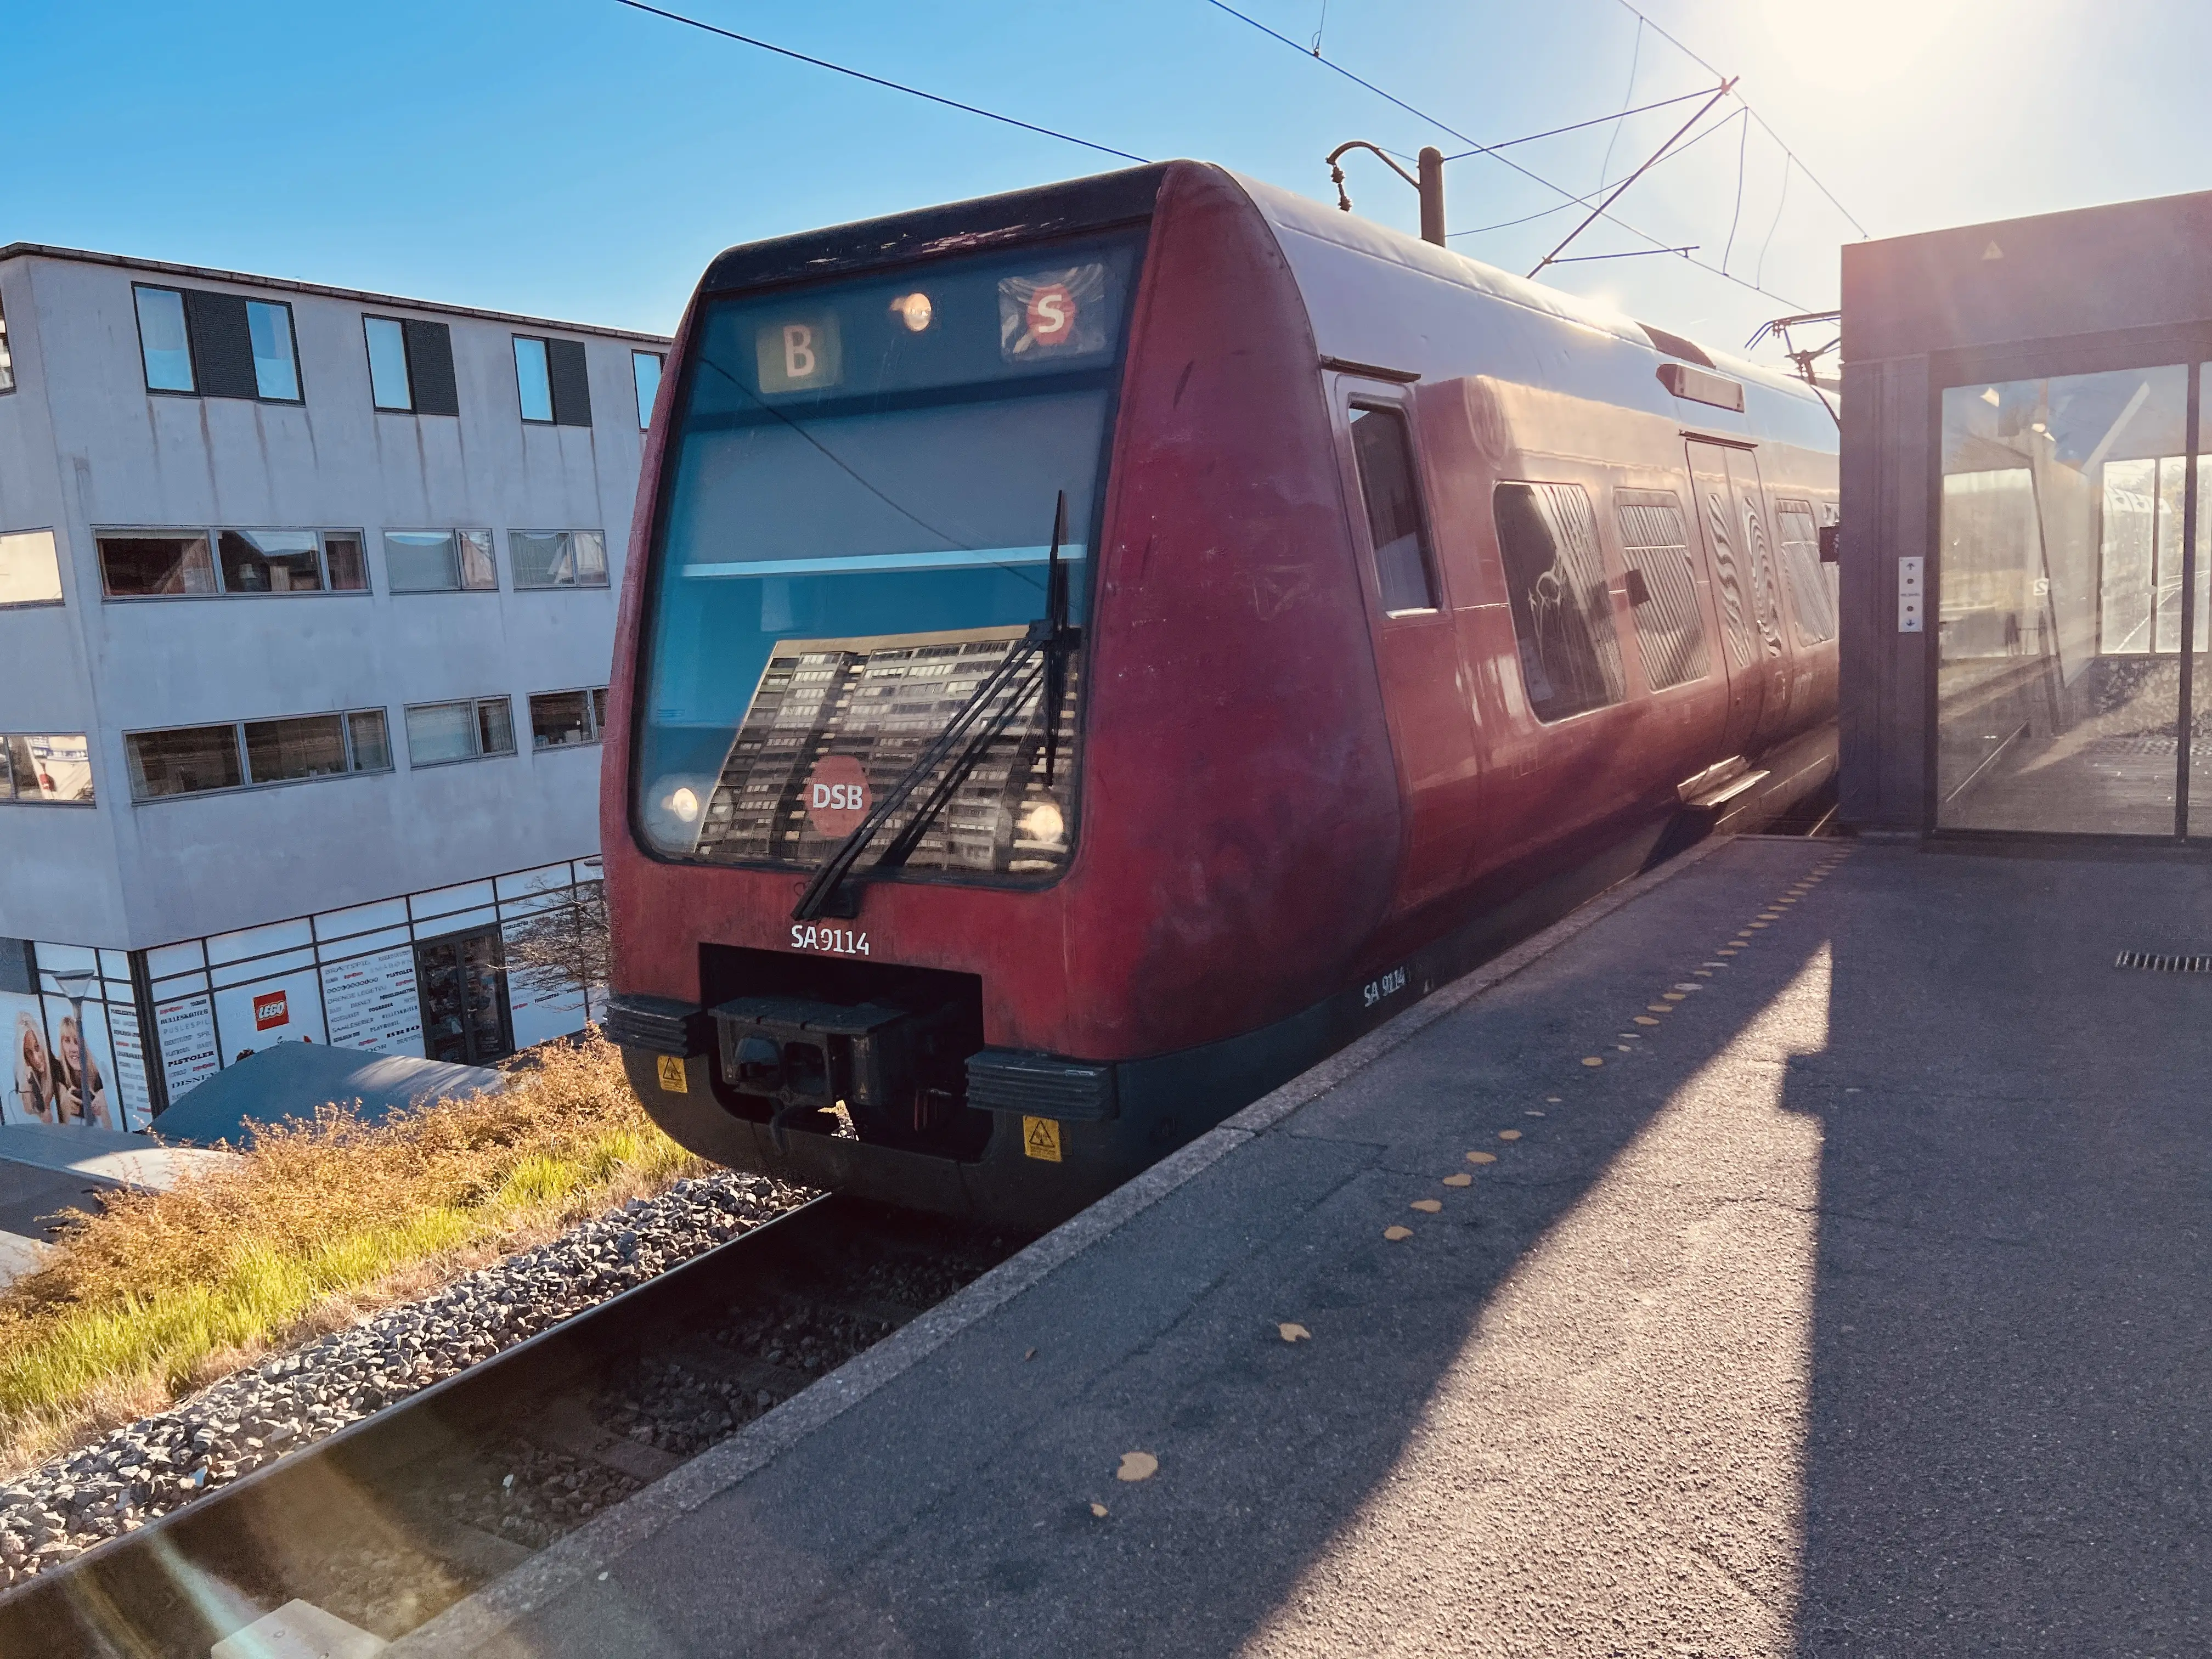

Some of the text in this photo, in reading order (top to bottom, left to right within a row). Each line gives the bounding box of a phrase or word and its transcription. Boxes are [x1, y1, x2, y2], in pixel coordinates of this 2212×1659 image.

[1037, 295, 1064, 334] S
[783, 325, 815, 377] B
[813, 783, 863, 810] DSB
[791, 925, 869, 955] SA9114
[1364, 966, 1405, 1007] SA 9114
[258, 1001, 285, 1020] LEGO
[167, 1051, 215, 1068] PISTOLER
